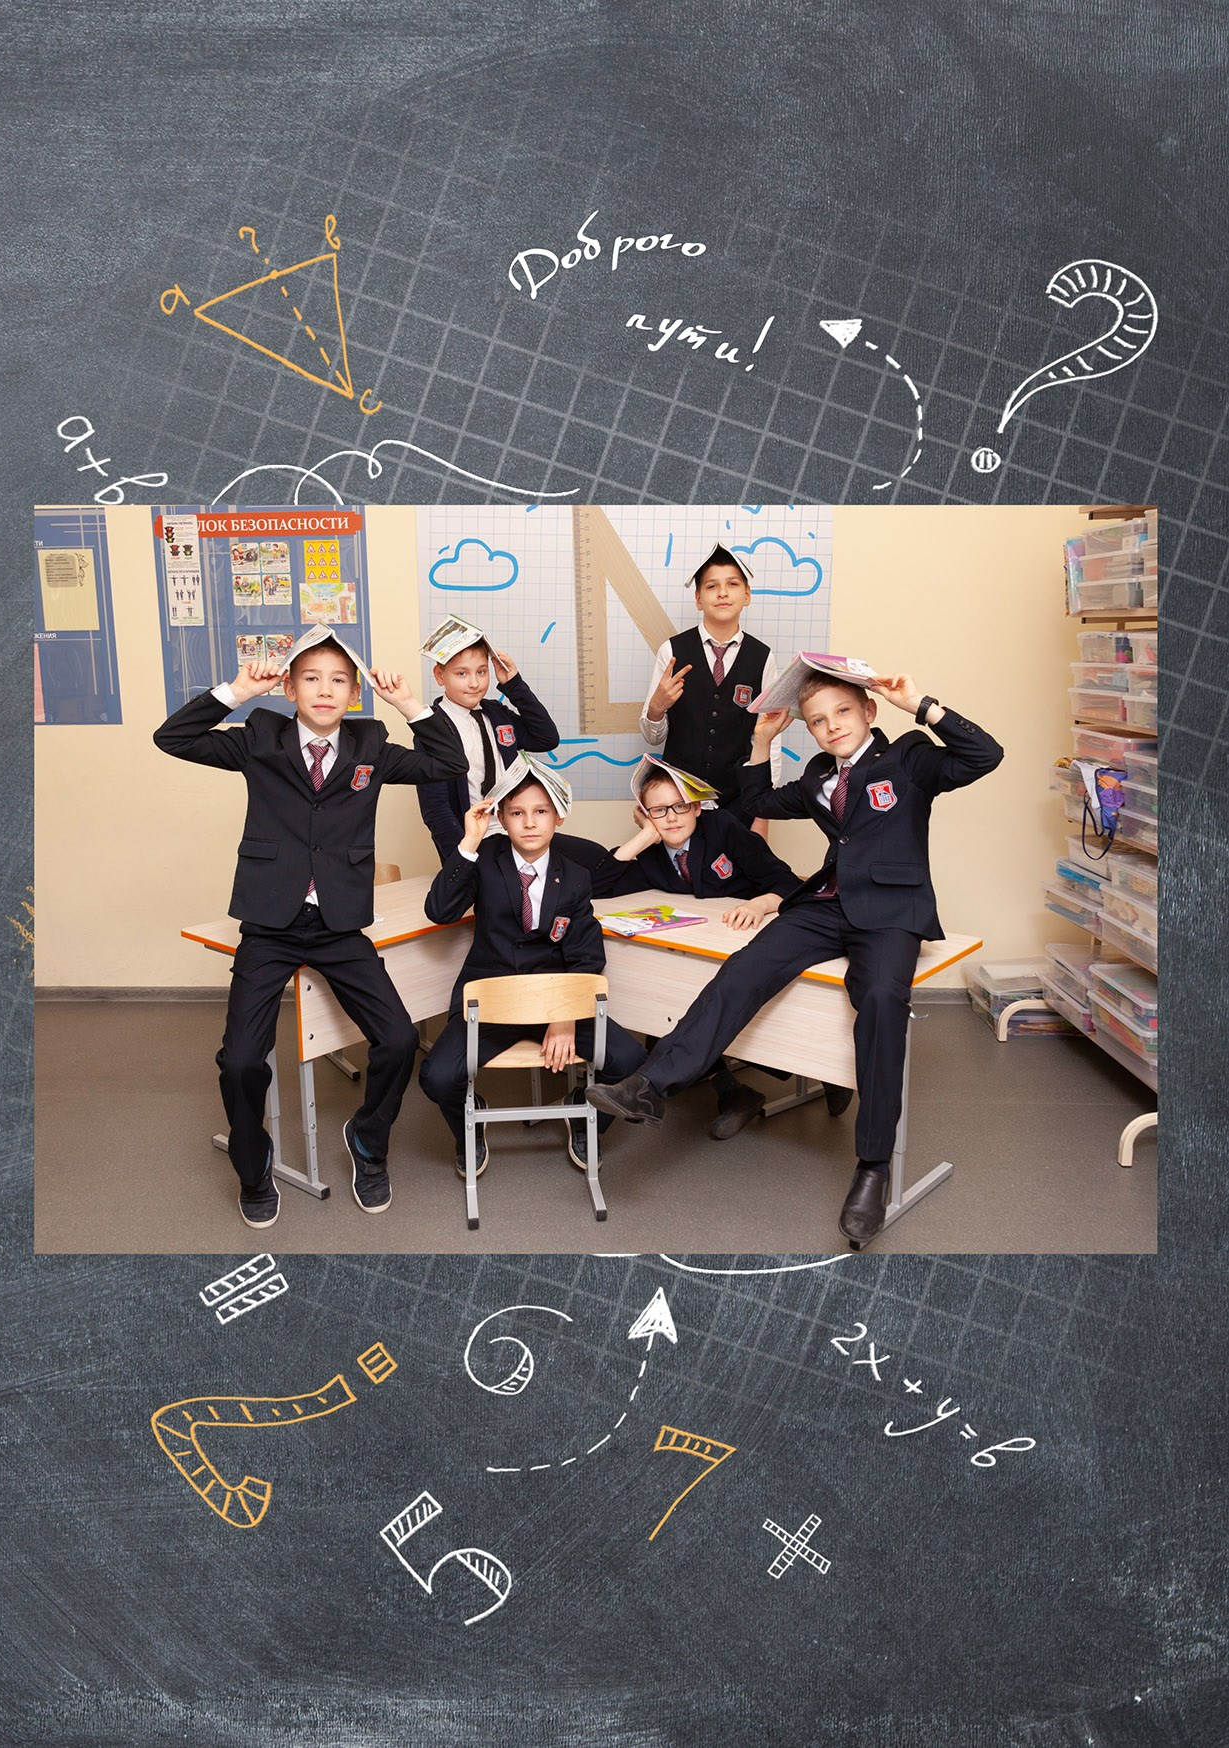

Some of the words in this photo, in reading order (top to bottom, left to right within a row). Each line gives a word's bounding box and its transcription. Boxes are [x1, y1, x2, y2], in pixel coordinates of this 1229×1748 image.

[508, 210, 707, 300] Доброго
[625, 313, 775, 372] пути!
[231, 517, 349, 531] БЕЗОПАСНОСТИ
[648, 1424, 738, 1543] 7
[378, 1490, 513, 1628] 5
